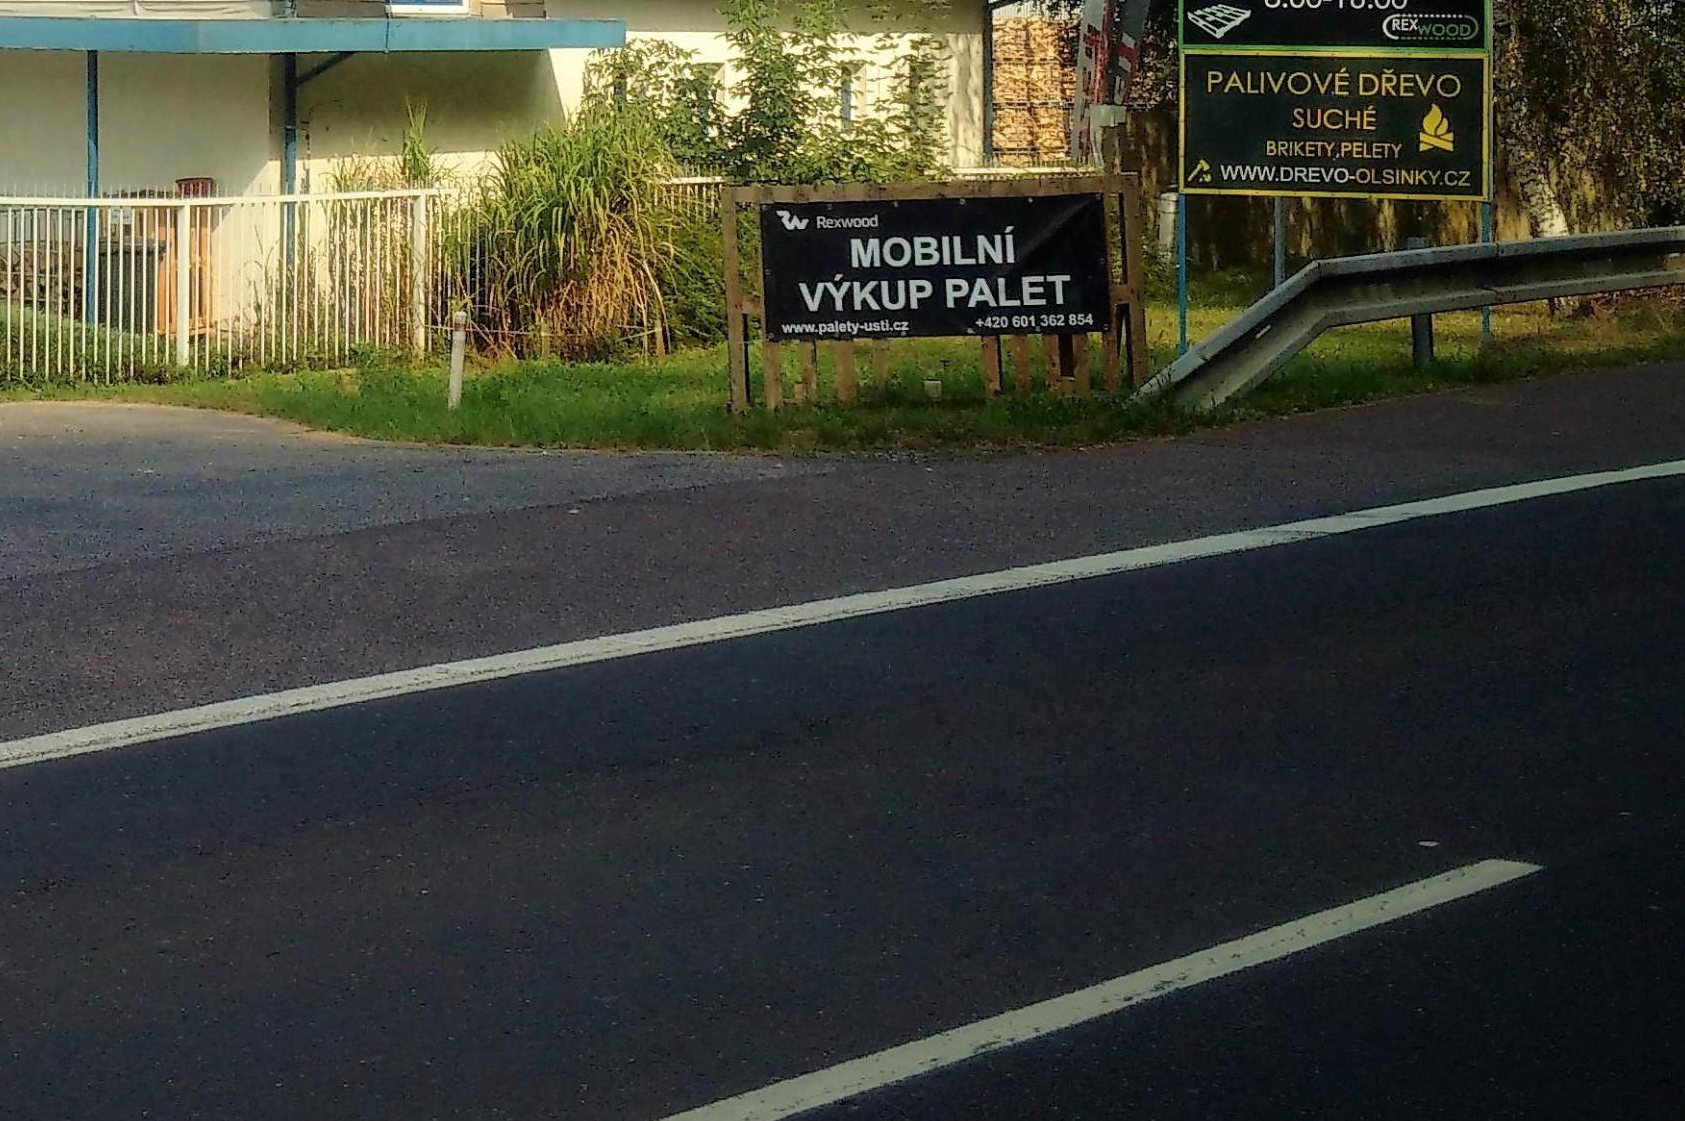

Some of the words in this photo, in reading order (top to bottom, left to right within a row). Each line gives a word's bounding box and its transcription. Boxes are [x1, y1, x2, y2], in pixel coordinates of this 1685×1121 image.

[1207, 67, 1350, 96] PALIVOVÉ
[1359, 68, 1462, 98] DŘEVO
[1292, 106, 1378, 130] SUCHÉ
[1220, 164, 1472, 187] WWW.DREVO-OLSINKY.CZ
[816, 215, 879, 229] Rexwood
[850, 226, 1015, 268] MOBILNÍ
[798, 274, 933, 312] VÝKUP
[945, 275, 1071, 309] PALET
[781, 319, 910, 336] www.palety-usti.cz
[976, 316, 1008, 328] +420
[1012, 315, 1036, 327] 601
[1040, 314, 1065, 326] 362
[1068, 313, 1093, 325] 854
